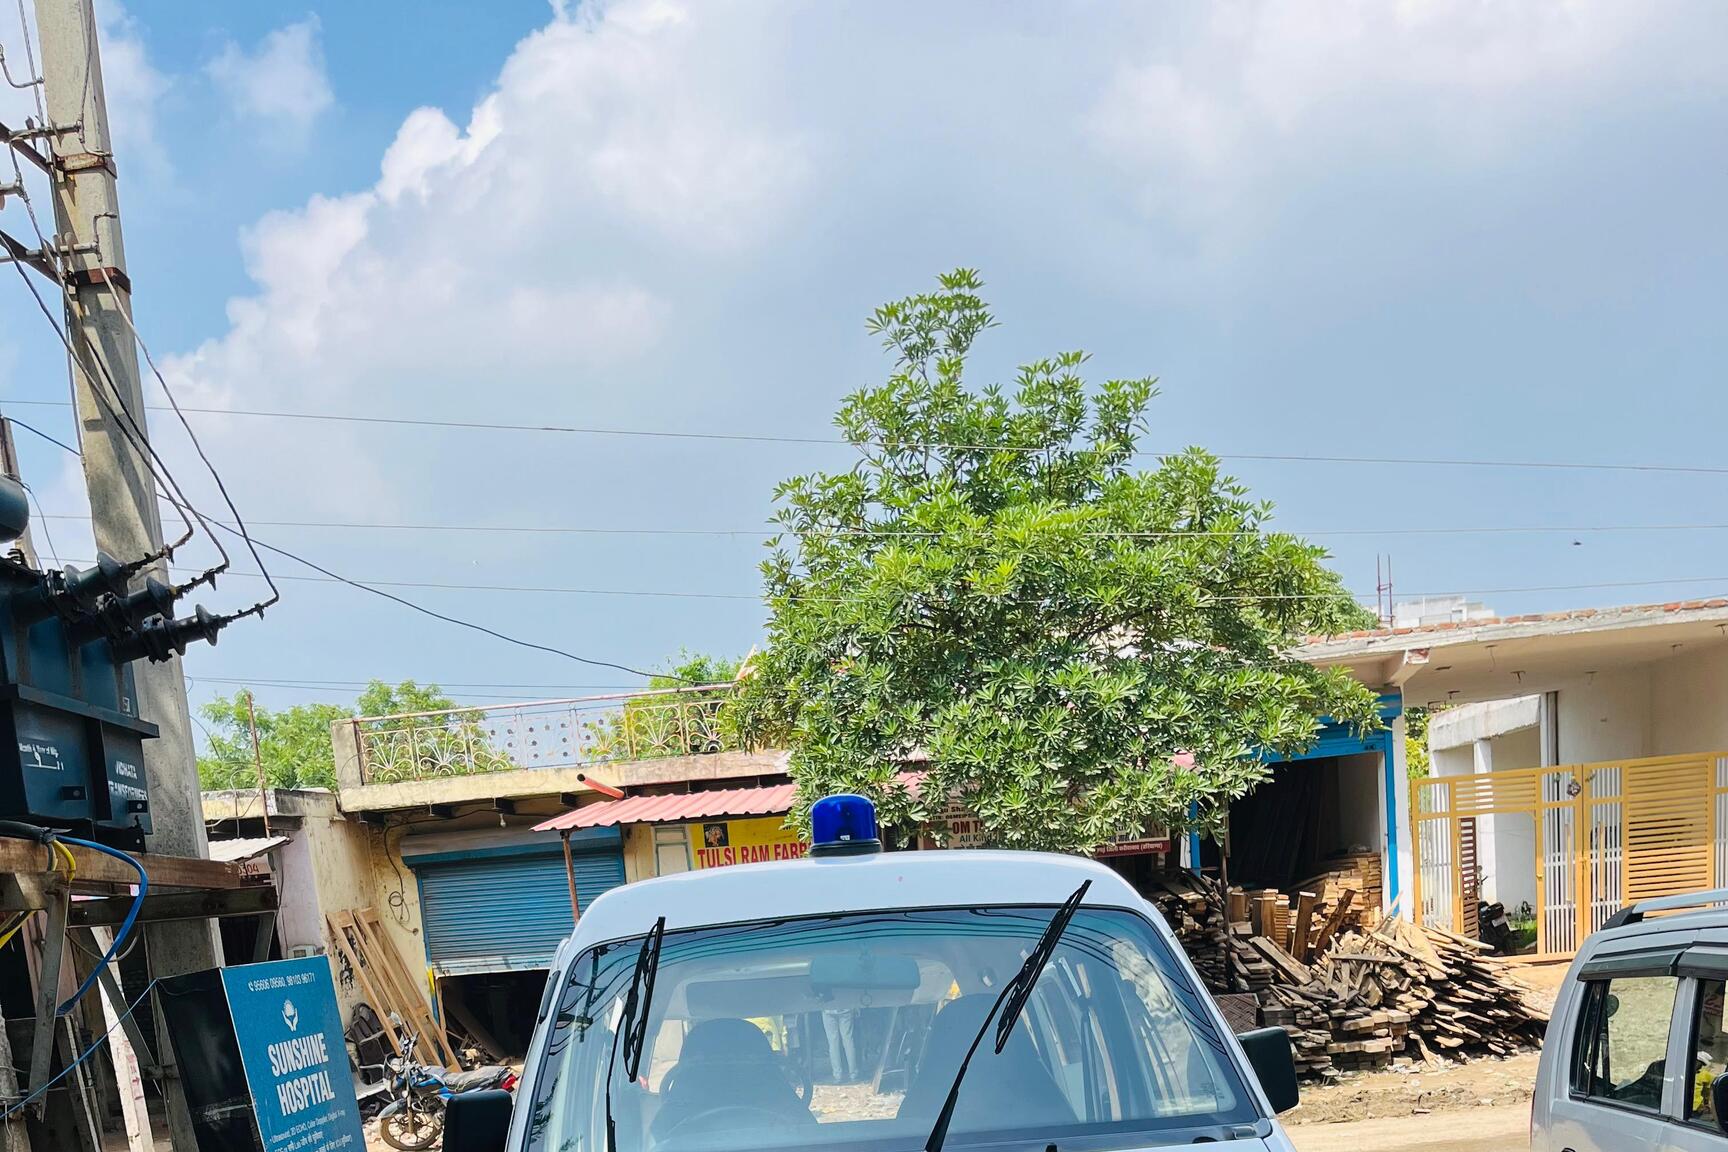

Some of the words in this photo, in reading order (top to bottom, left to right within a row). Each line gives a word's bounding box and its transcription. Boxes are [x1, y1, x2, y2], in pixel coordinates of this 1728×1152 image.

[952, 821, 970, 834] OM
[697, 846, 737, 869] TULSI
[741, 844, 770, 864] RAM
[774, 842, 811, 861] FABR
[268, 1033, 328, 1077] SUNSHINE
[277, 1071, 335, 1117] HOSPITAL
